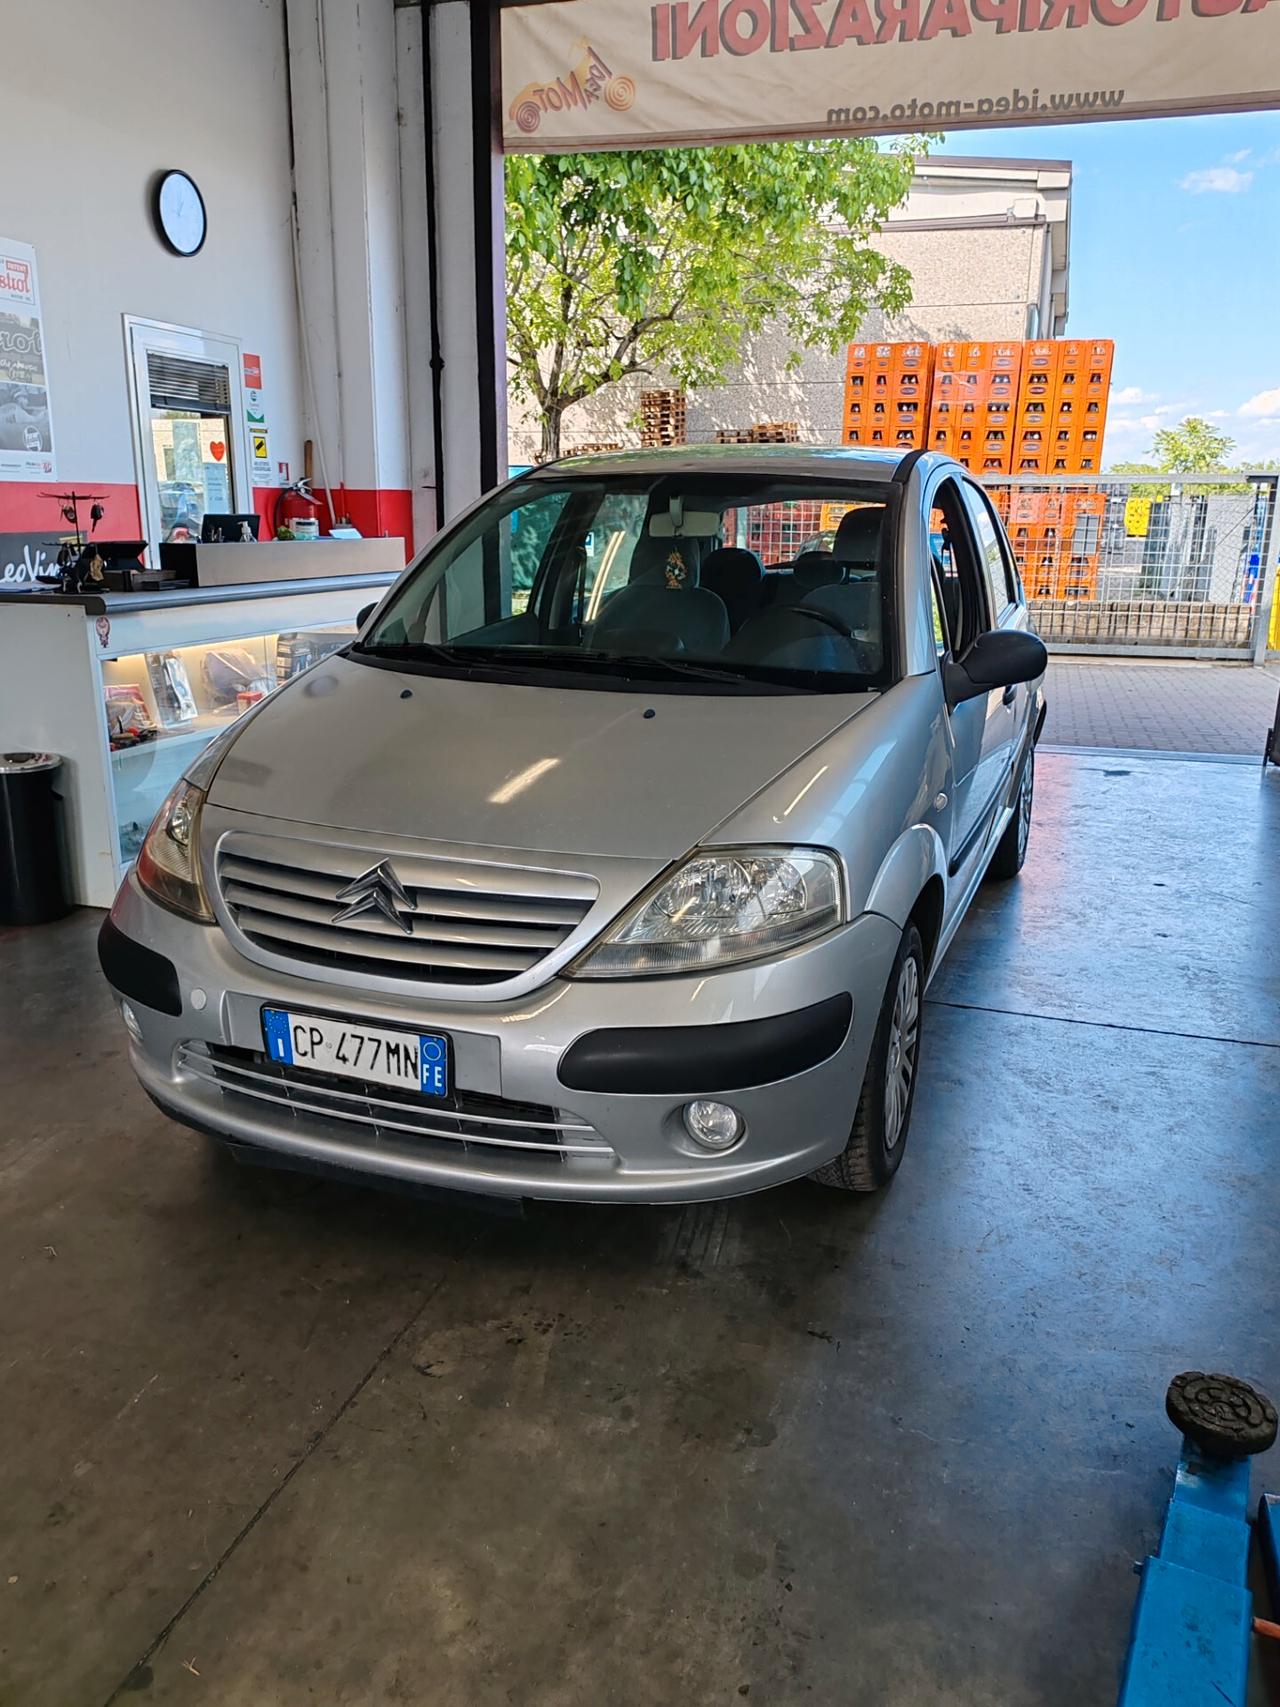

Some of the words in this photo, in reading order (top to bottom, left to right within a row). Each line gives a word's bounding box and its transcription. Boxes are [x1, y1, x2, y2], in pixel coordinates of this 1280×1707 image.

[277, 1038, 284, 1057] I
[293, 1025, 323, 1059] CP
[335, 1032, 419, 1079] 477MN
[422, 1064, 442, 1087] FE
